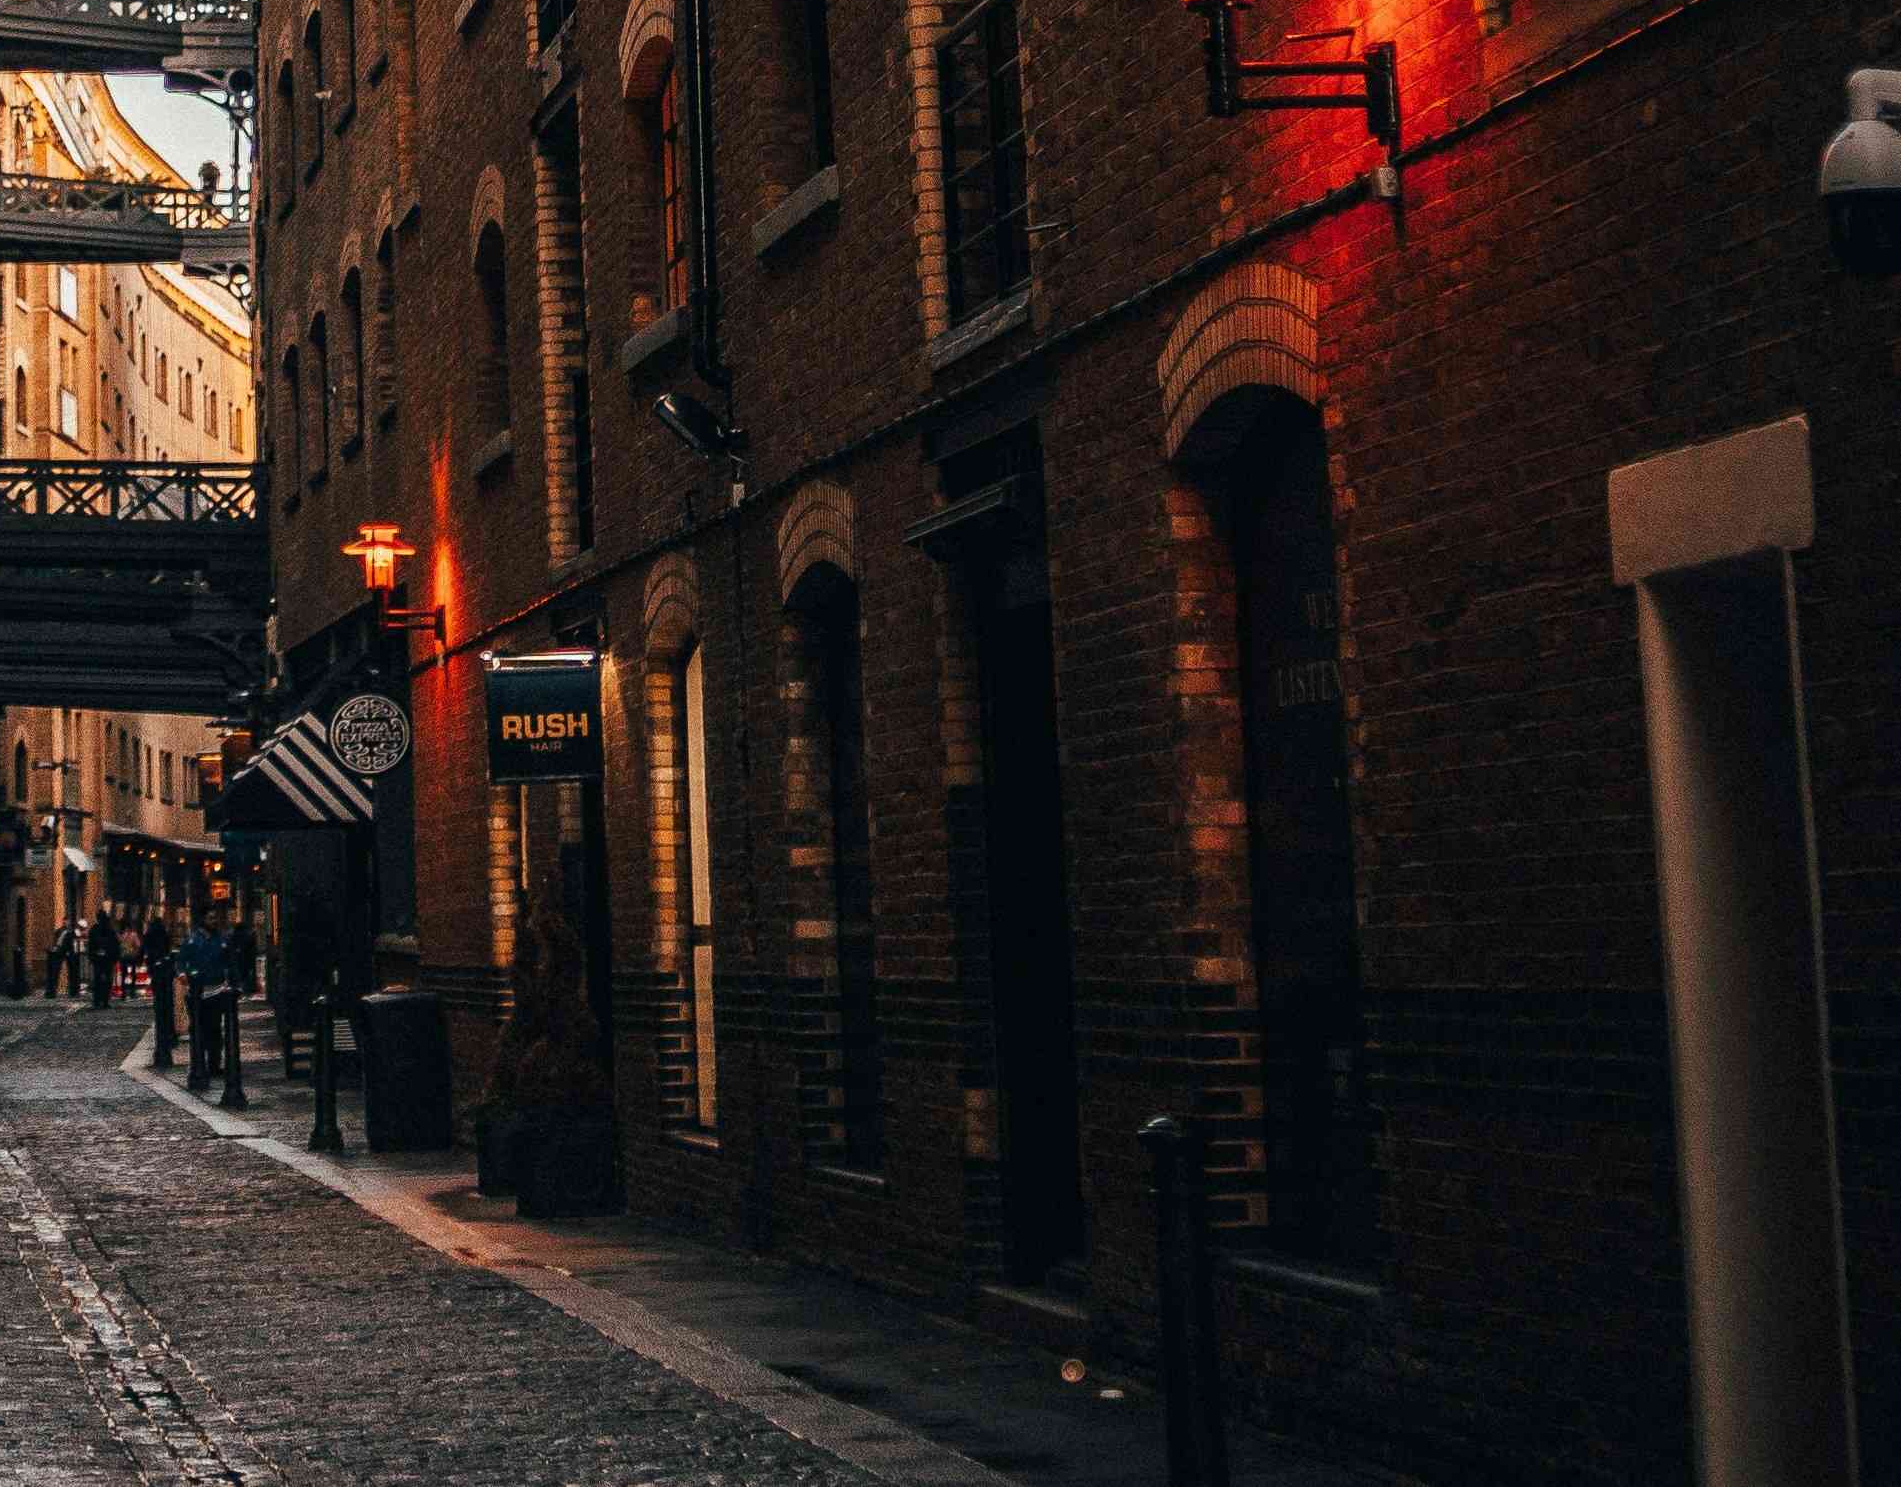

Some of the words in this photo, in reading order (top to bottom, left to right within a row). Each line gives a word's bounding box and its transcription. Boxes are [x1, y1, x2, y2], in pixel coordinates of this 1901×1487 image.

[350, 721, 389, 733] PIZZA
[501, 712, 590, 740] RUSH
[531, 740, 563, 753] HAIR
